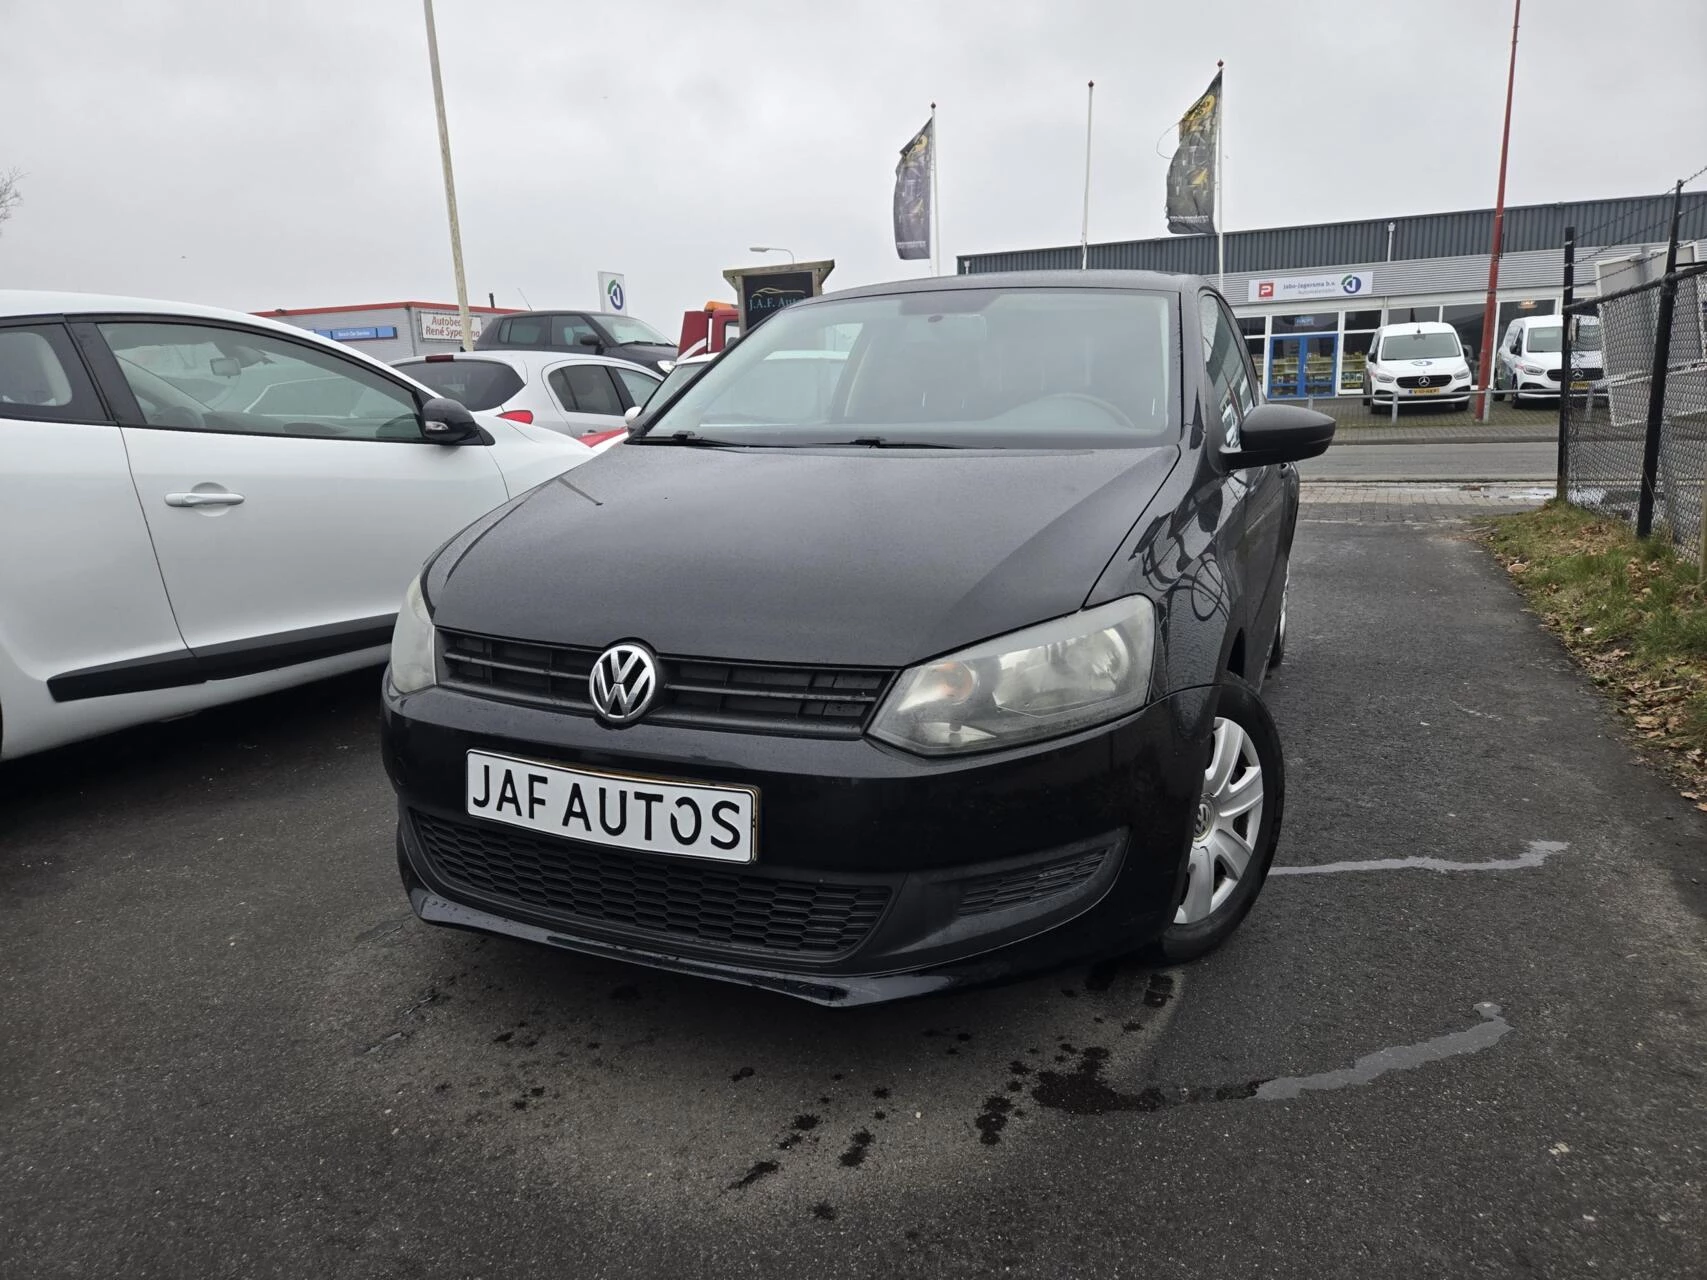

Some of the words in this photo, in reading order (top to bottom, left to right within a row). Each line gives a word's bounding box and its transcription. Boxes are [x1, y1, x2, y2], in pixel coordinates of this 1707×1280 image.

[425, 325, 445, 337] René
[473, 765, 548, 819] JAF
[562, 783, 740, 850] AUTOS
